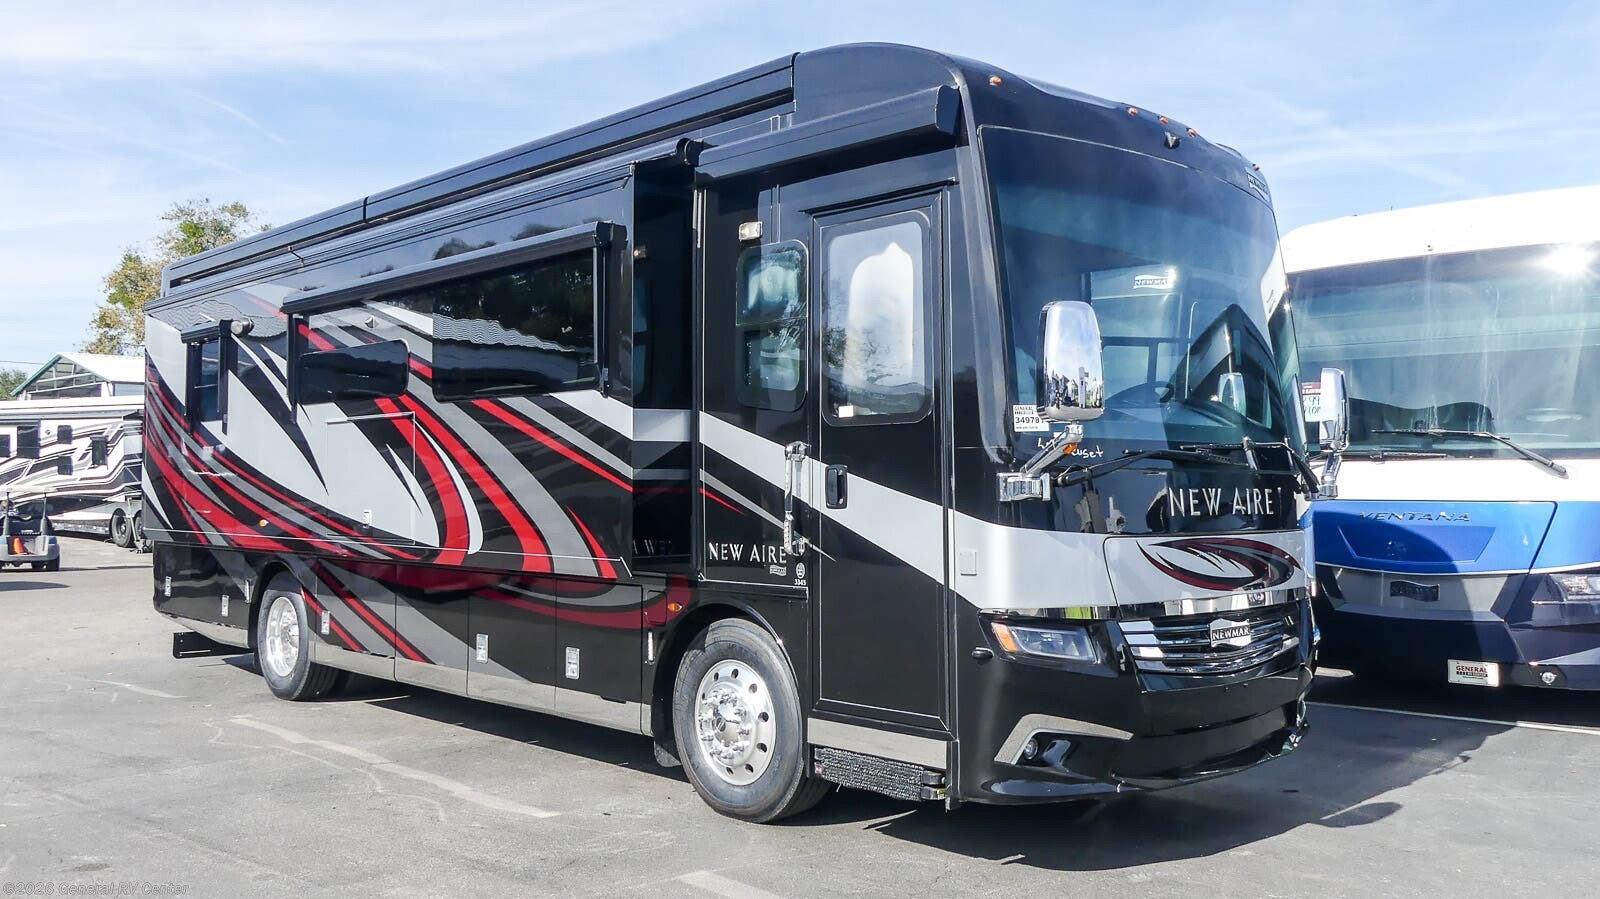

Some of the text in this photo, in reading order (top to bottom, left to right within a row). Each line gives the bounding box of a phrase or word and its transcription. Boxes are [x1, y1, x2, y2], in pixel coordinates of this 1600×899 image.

[1168, 487, 1274, 517] NEW AIRE
[1360, 511, 1470, 522] VENTANA
[708, 542, 787, 564] NEW AIRE
[1211, 626, 1250, 641] NEWMAR
[1455, 665, 1488, 673] GENERAL
